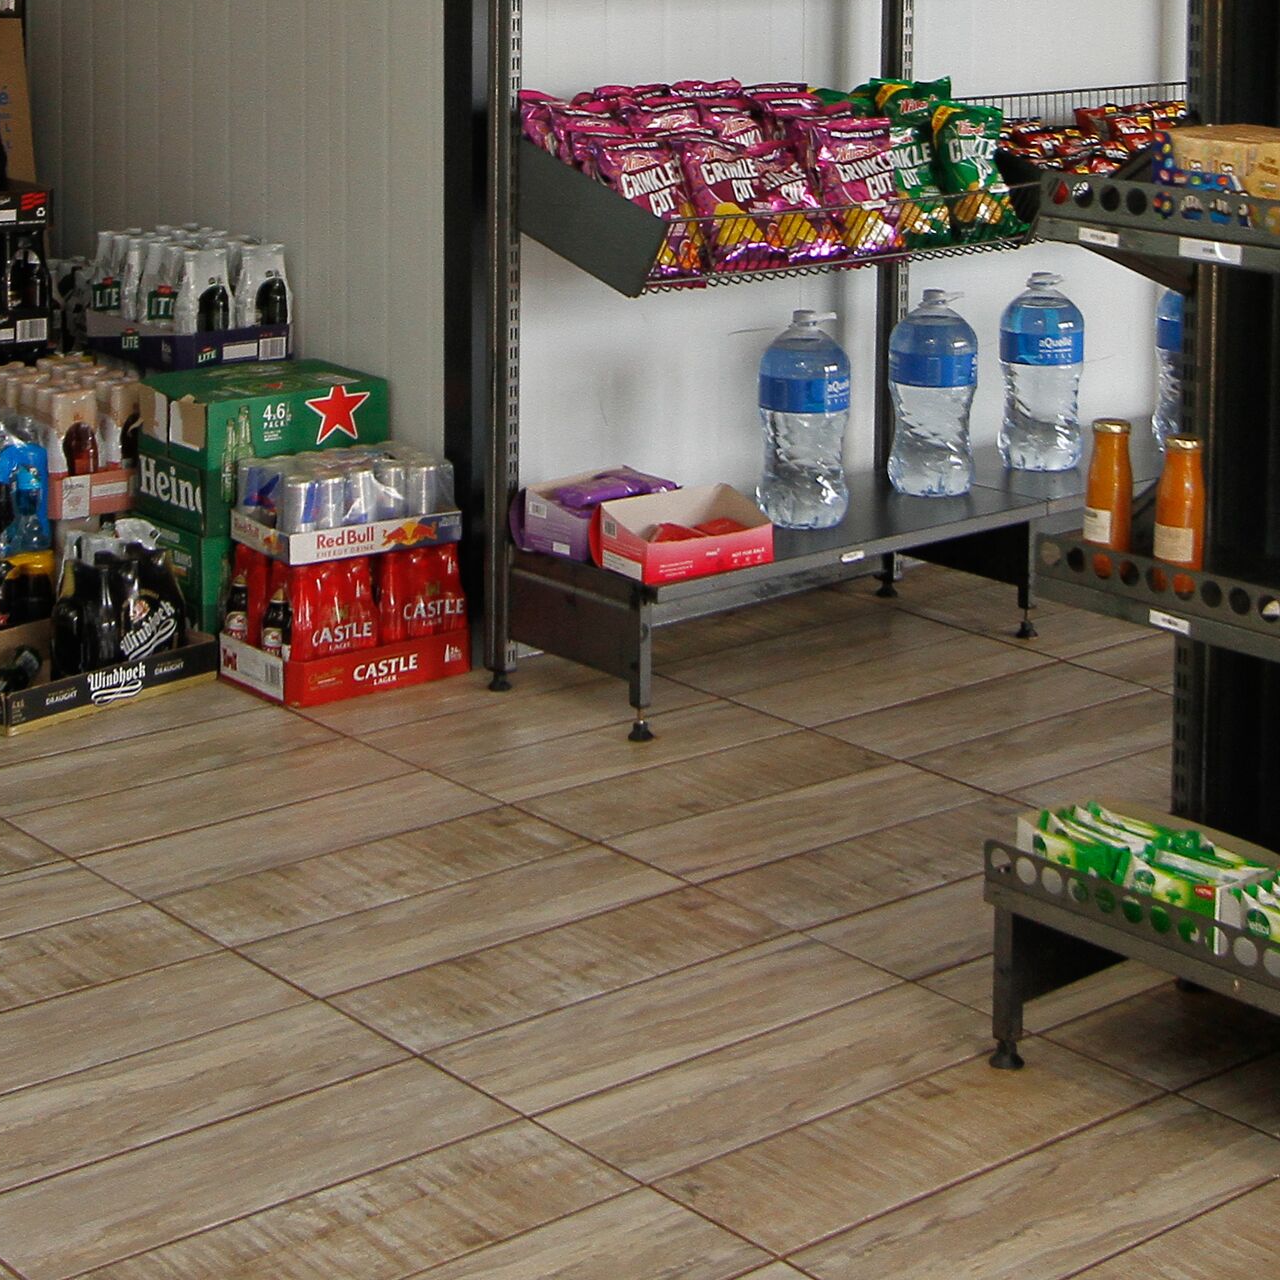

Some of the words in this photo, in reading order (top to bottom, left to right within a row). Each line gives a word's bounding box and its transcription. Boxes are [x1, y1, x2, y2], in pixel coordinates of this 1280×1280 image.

[620, 162, 677, 200] CRINKLE
[732, 179, 756, 203] CUT
[866, 171, 893, 200] CUT
[648, 189, 676, 218] CUT
[121, 336, 139, 349] LITE
[198, 350, 217, 363] LITE
[317, 531, 345, 549] Red
[347, 526, 374, 544] Bull
[403, 598, 464, 621] CASTLE
[119, 601, 176, 657] Windhoek
[312, 621, 373, 648] CASTLE
[87, 663, 145, 694] Windhoek
[154, 663, 184, 675] DRAUGHT
[353, 654, 418, 681] CASTLE
[373, 675, 397, 685] LAGER
[45, 689, 78, 705] DRAUGHT
